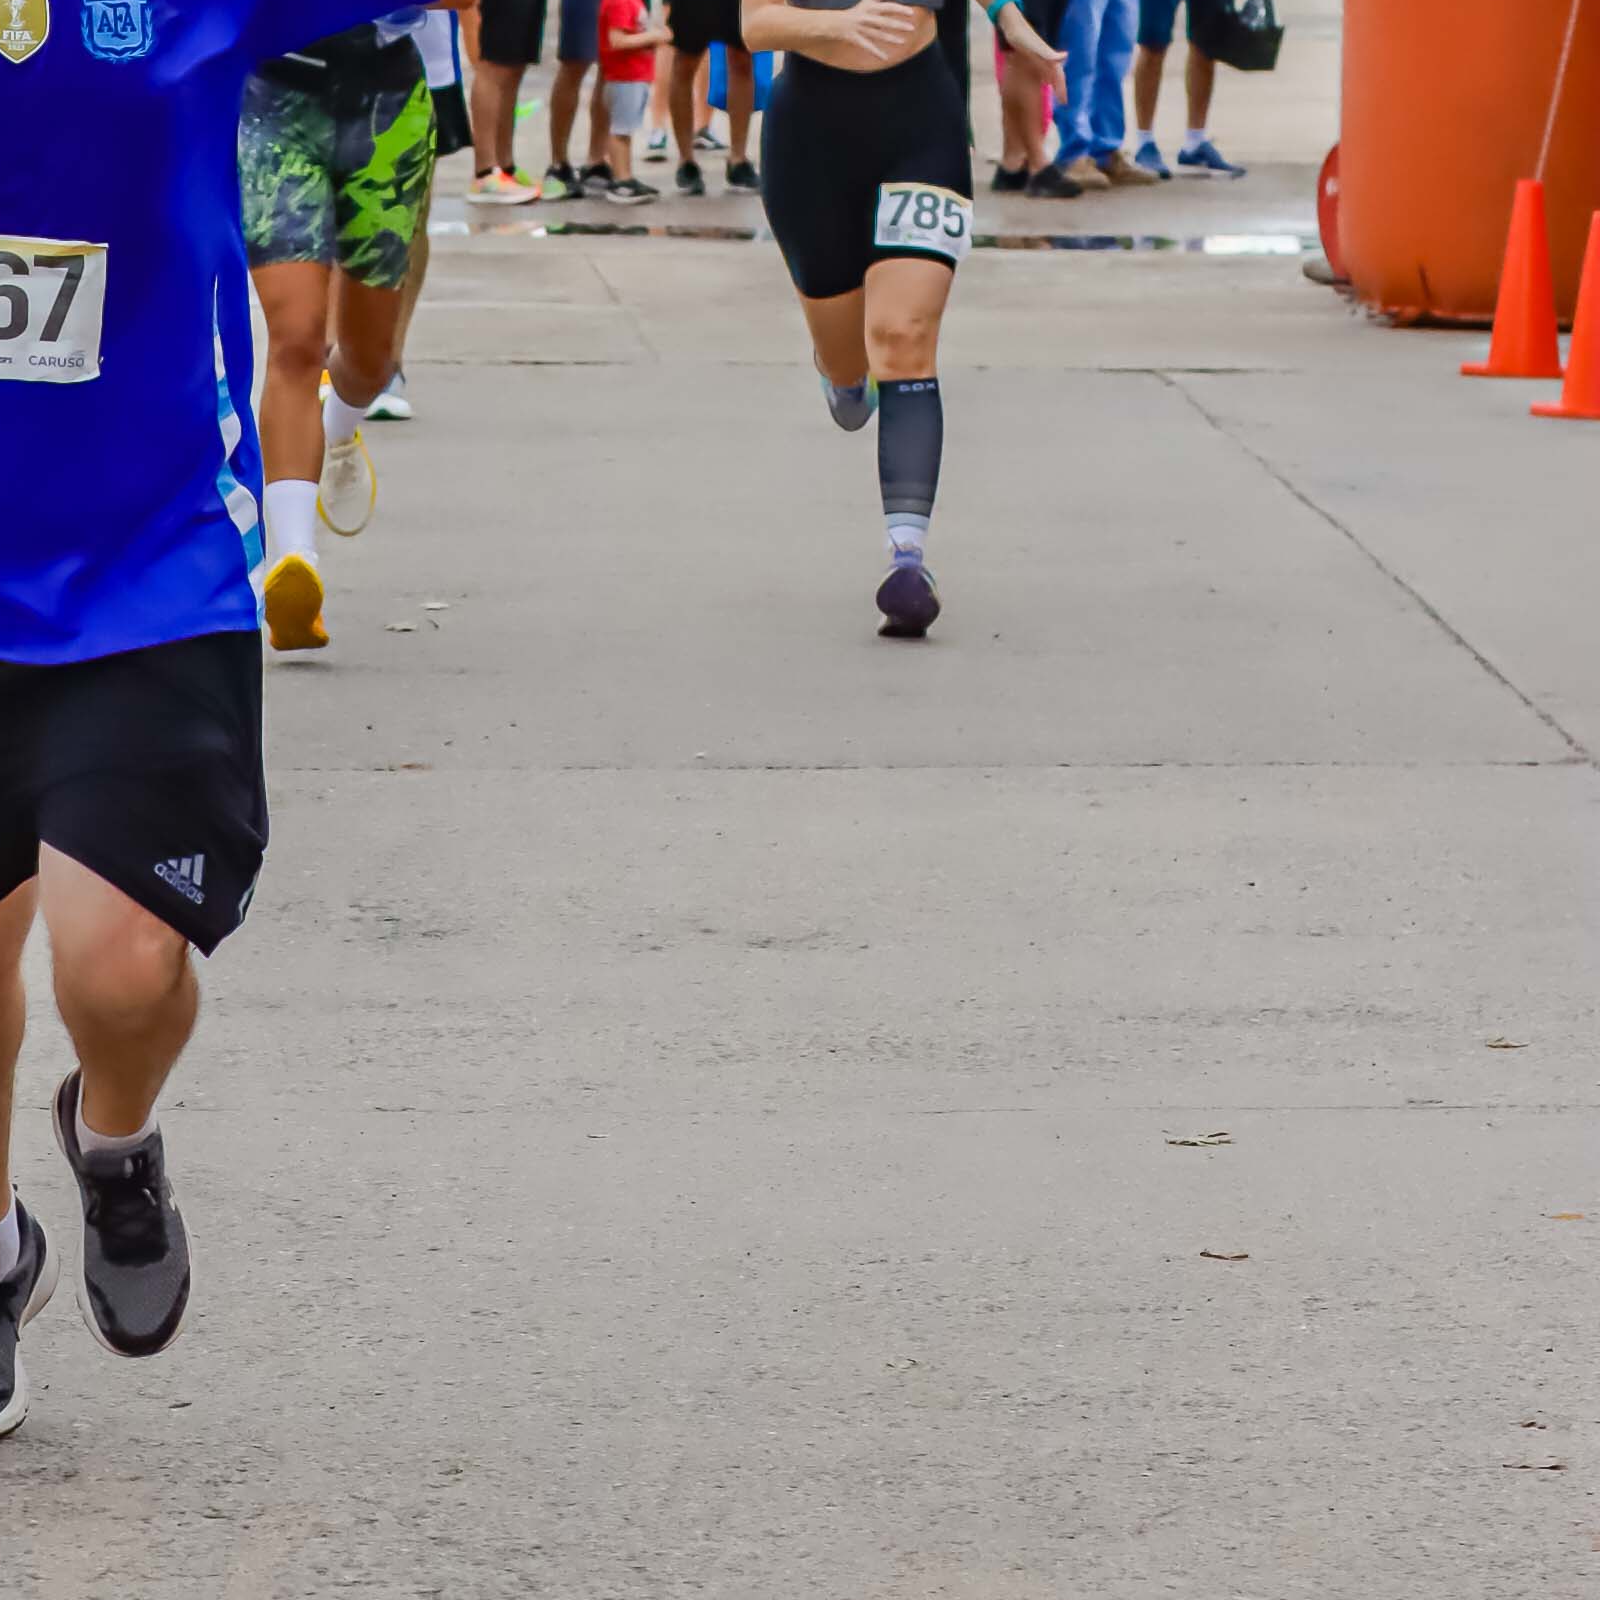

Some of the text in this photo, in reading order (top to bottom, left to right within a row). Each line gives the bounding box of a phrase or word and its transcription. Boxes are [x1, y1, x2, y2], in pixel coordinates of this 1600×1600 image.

[2, 29, 32, 40] FIFA
[97, 2, 137, 40] AFA
[889, 190, 964, 238] 785
[28, 355, 85, 368] CARUSO
[154, 863, 205, 904] adidas
